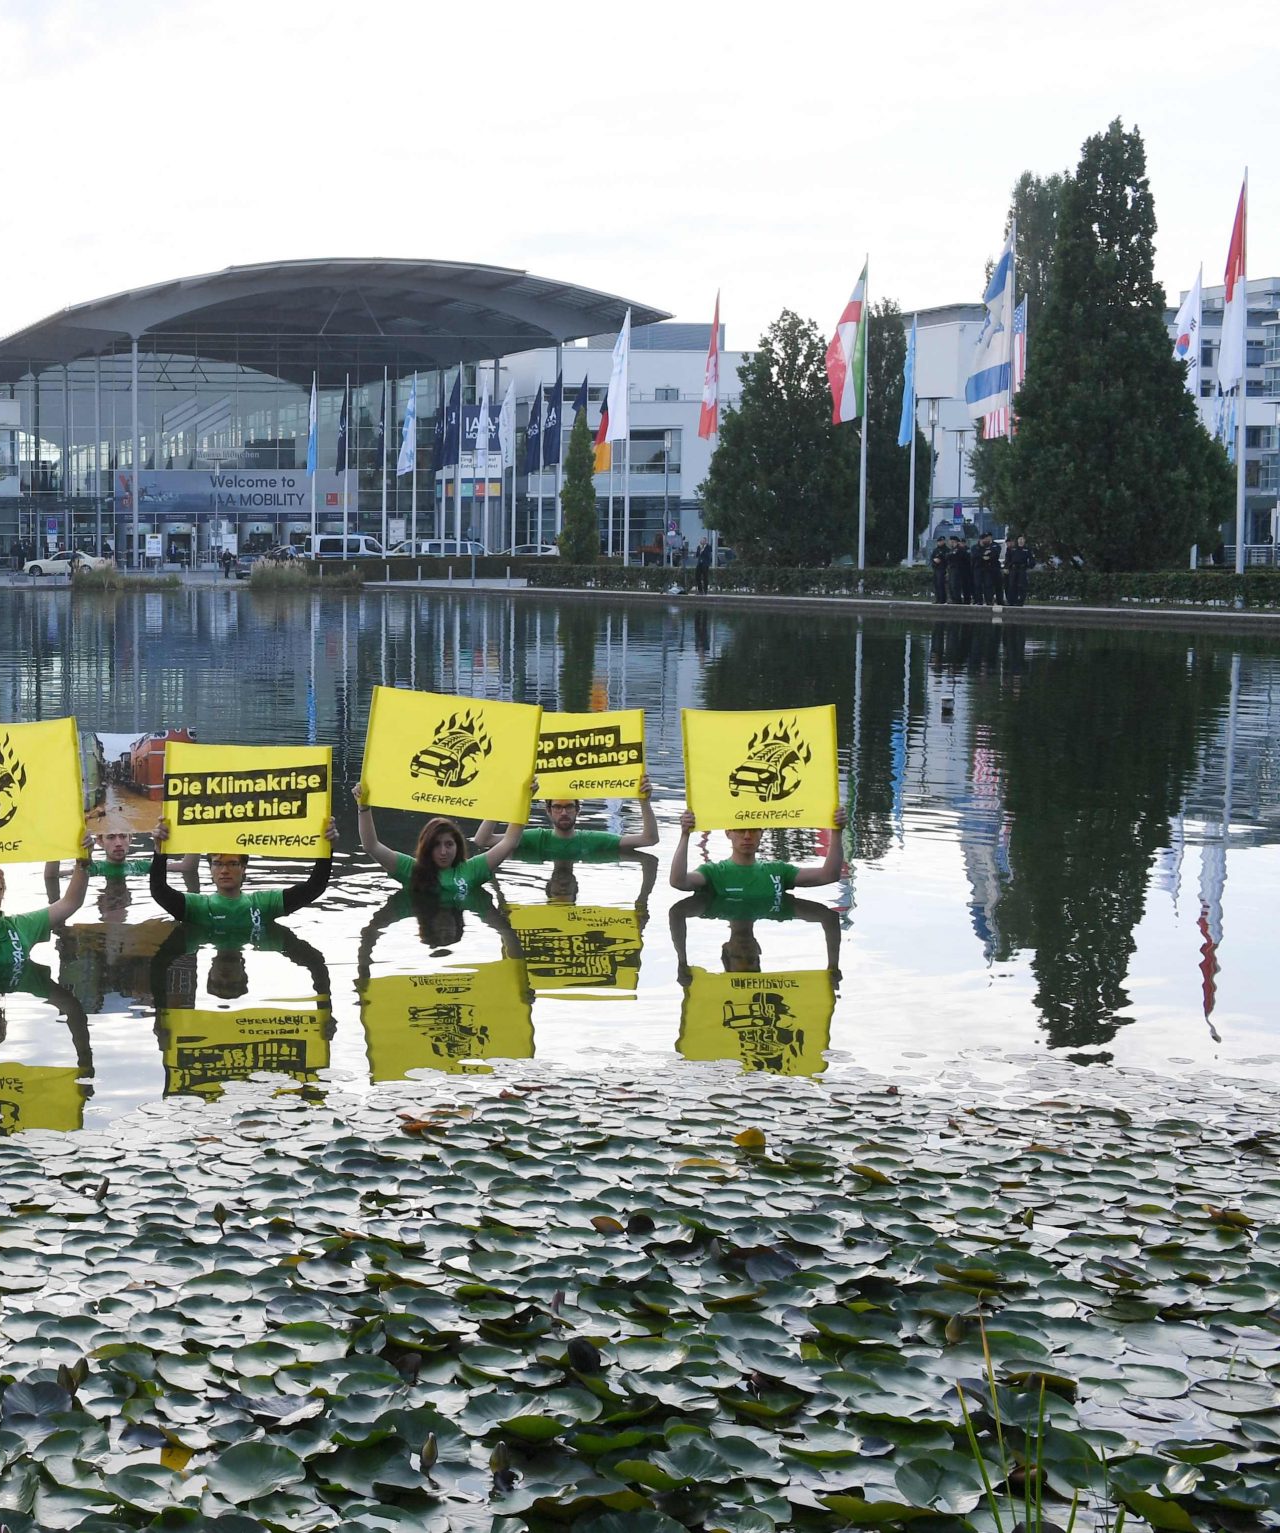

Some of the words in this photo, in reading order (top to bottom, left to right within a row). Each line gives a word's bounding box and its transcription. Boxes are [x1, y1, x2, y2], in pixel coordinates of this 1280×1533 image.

[209, 475, 277, 488] Welcome
[282, 476, 296, 488] to
[209, 493, 236, 506] IAA
[239, 492, 305, 506] MOBILITY
[557, 733, 615, 750] Driving
[575, 749, 639, 766] Change
[167, 777, 202, 796] Die
[206, 772, 321, 795] Klimakrise
[569, 778, 639, 791] GREENPEACE
[411, 791, 478, 807] GREENPEACE
[182, 801, 254, 821] startet
[258, 797, 302, 817] hier
[734, 809, 804, 821] GREENPEACE
[235, 833, 321, 847] GREENPEACE
